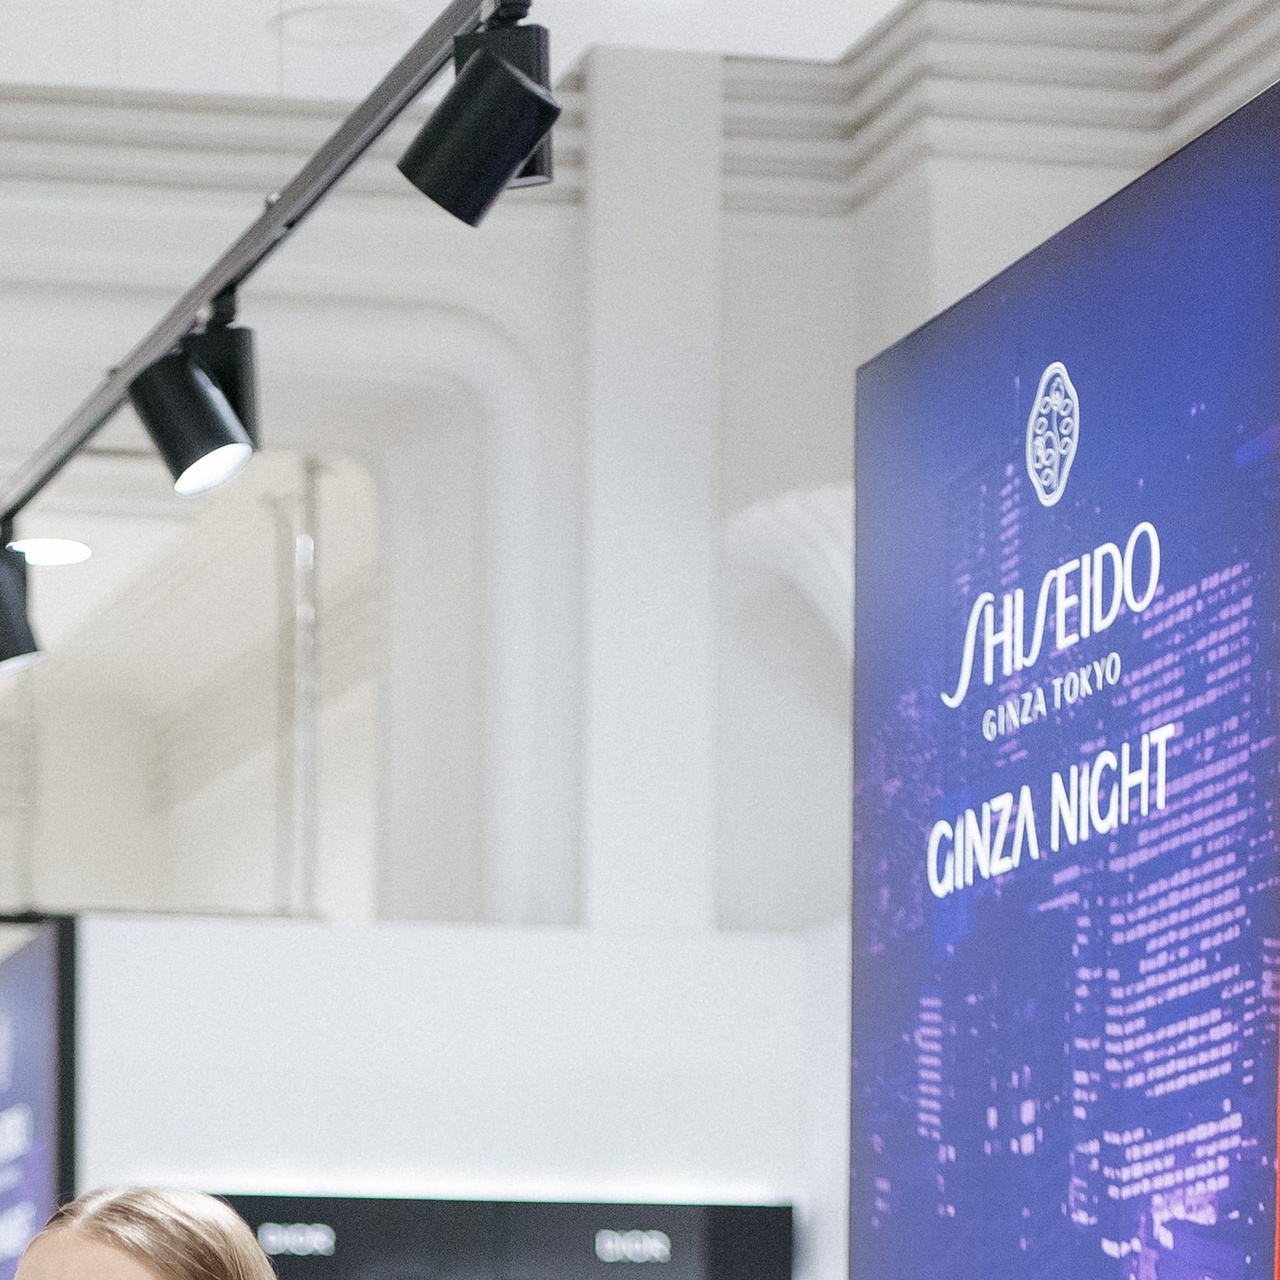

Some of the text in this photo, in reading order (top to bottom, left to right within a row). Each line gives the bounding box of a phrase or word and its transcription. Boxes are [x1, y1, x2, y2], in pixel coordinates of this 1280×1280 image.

[941, 522, 1161, 708] SHISEIDO
[981, 652, 1121, 741] GINZA TOKYO
[927, 723, 1175, 898] GINZA NIGHT
